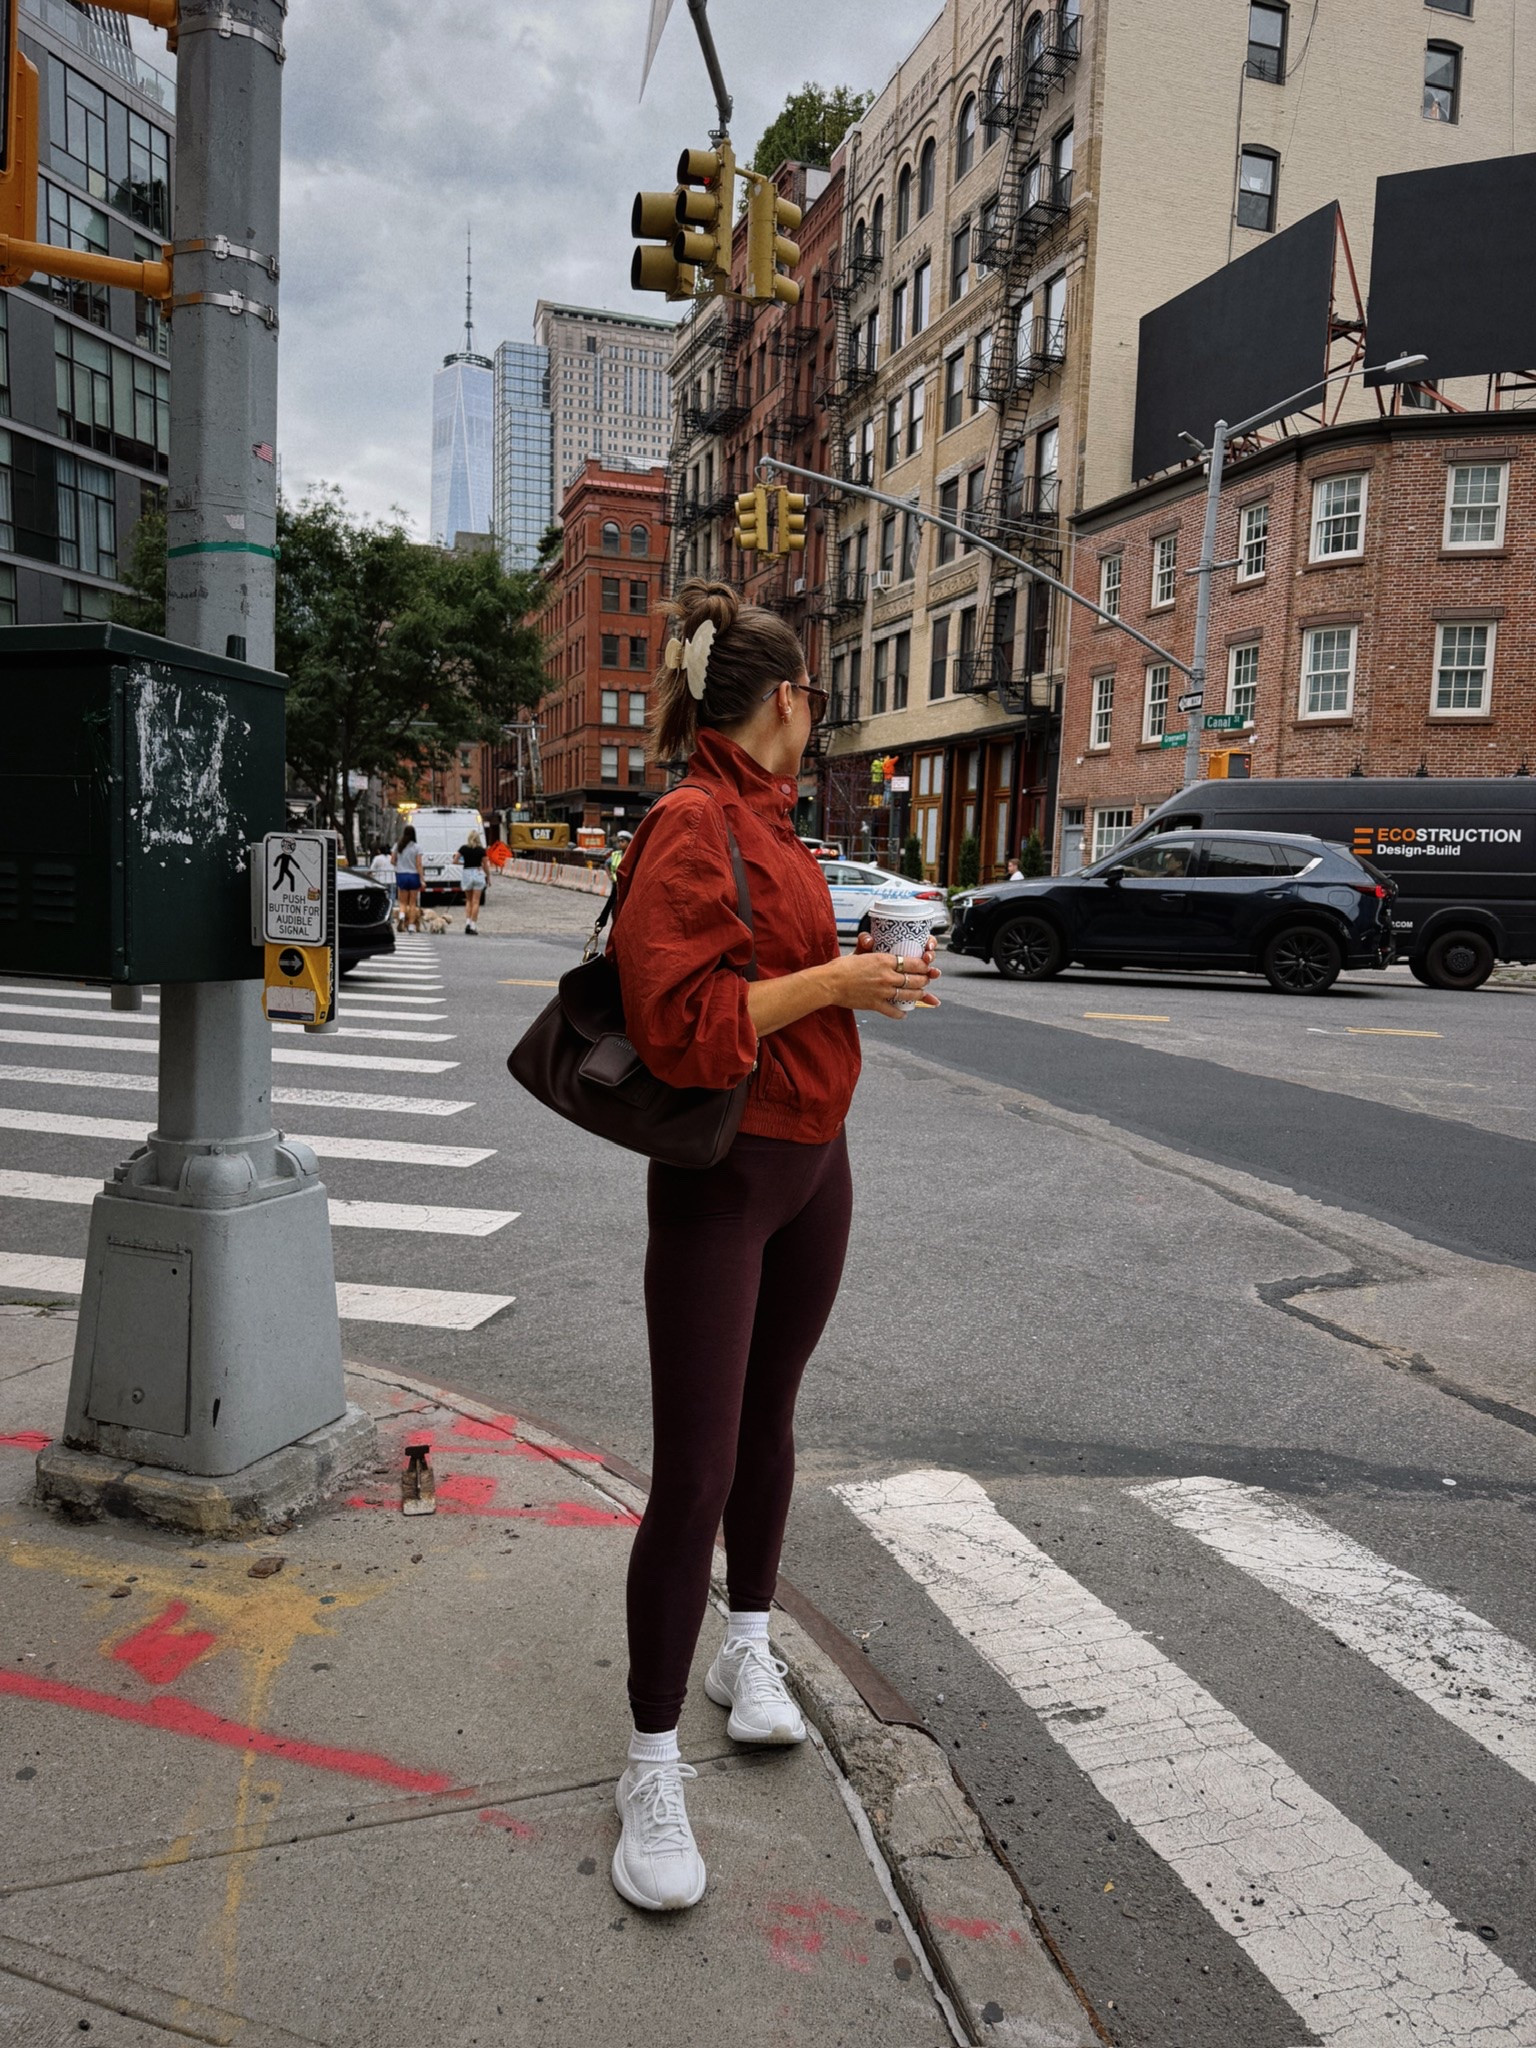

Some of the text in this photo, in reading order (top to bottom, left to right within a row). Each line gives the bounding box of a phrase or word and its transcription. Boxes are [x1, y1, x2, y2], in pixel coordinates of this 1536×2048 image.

[1207, 717, 1231, 728] Canal
[533, 828, 551, 840] CAT
[1377, 828, 1522, 843] ECOSTRUCTION
[1376, 844, 1461, 857] Design-Build
[283, 894, 306, 904] PUSH
[269, 903, 319, 916] BUTTON FOR
[276, 915, 312, 926] AUDIBLE
[279, 925, 309, 936] SIGNAL
